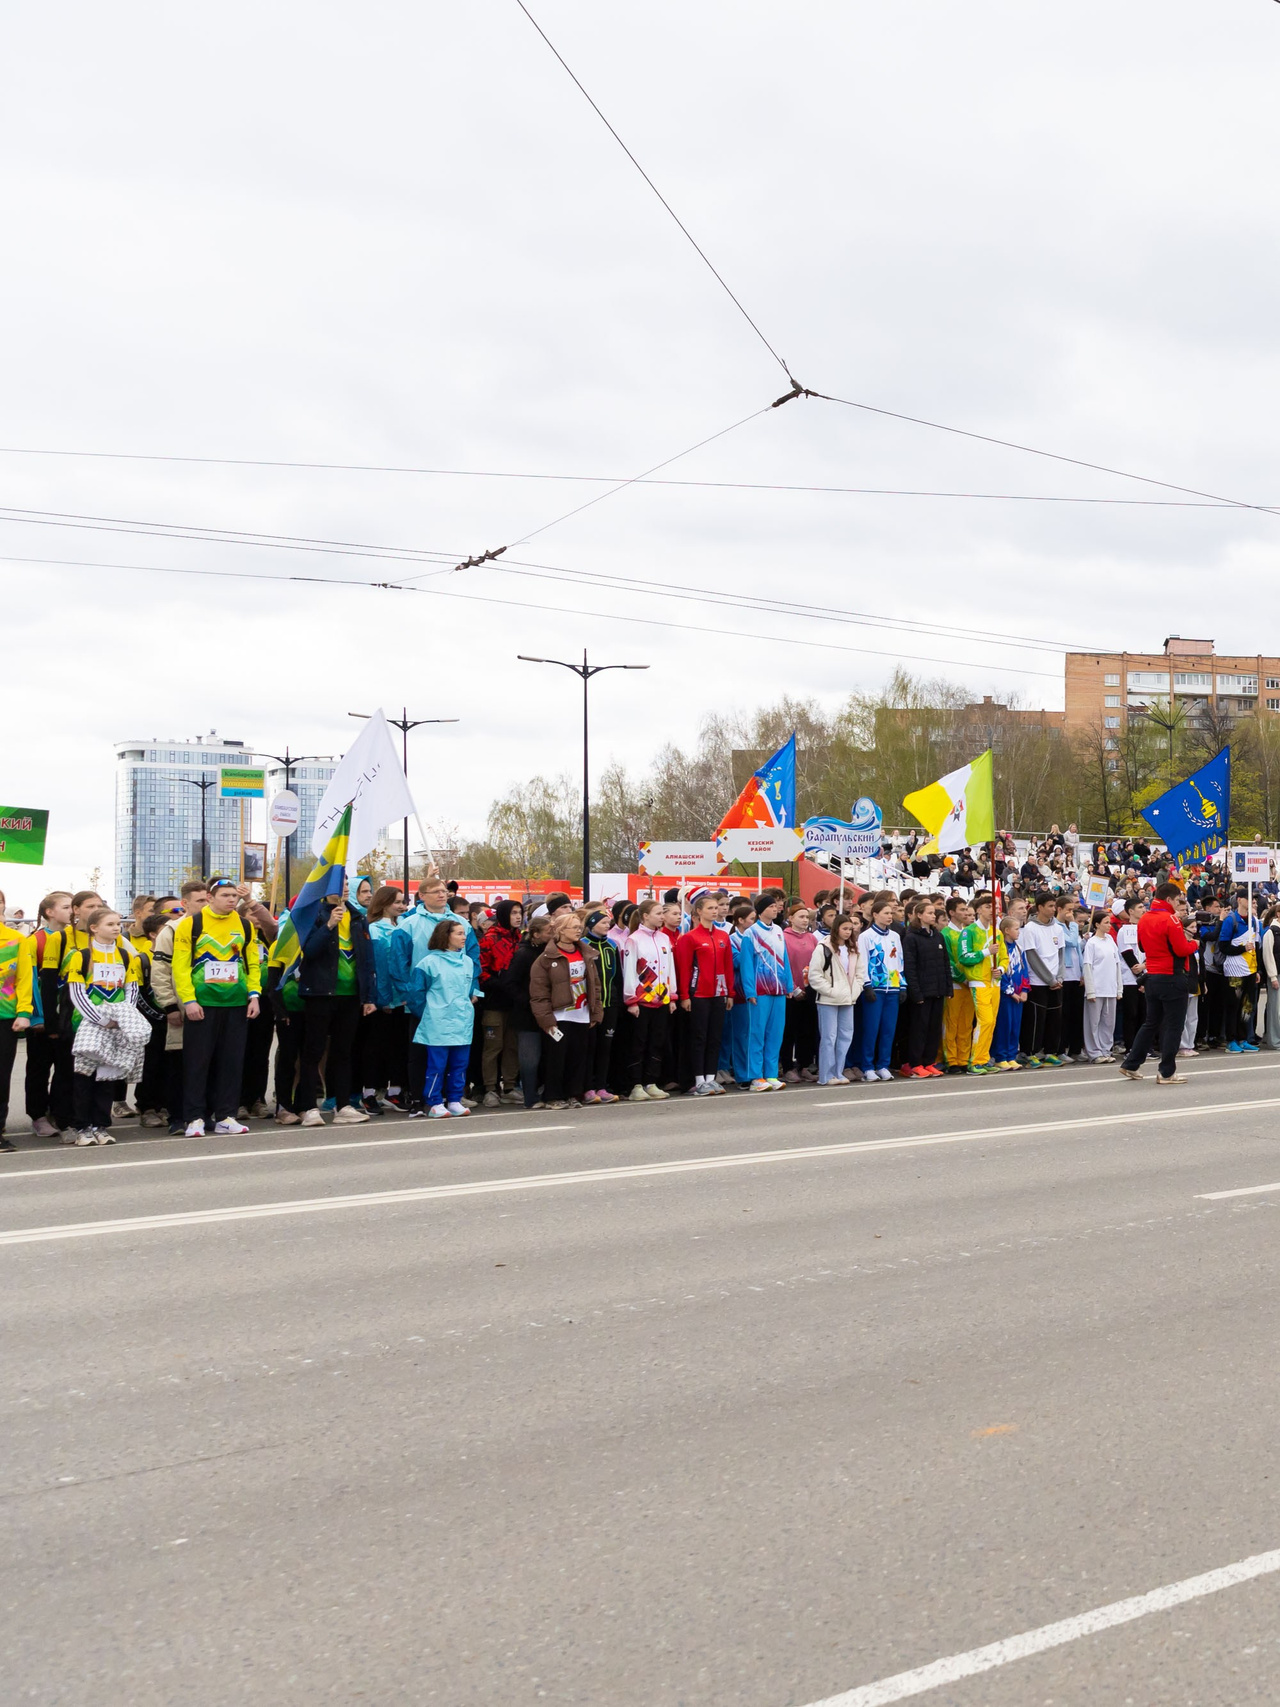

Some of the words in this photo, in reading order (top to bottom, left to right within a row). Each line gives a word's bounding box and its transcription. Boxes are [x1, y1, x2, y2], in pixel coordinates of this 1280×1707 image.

[806, 830, 875, 845] Сарапульский
[846, 842, 875, 854] район
[100, 970, 110, 978] 17
[210, 967, 221, 976] 17
